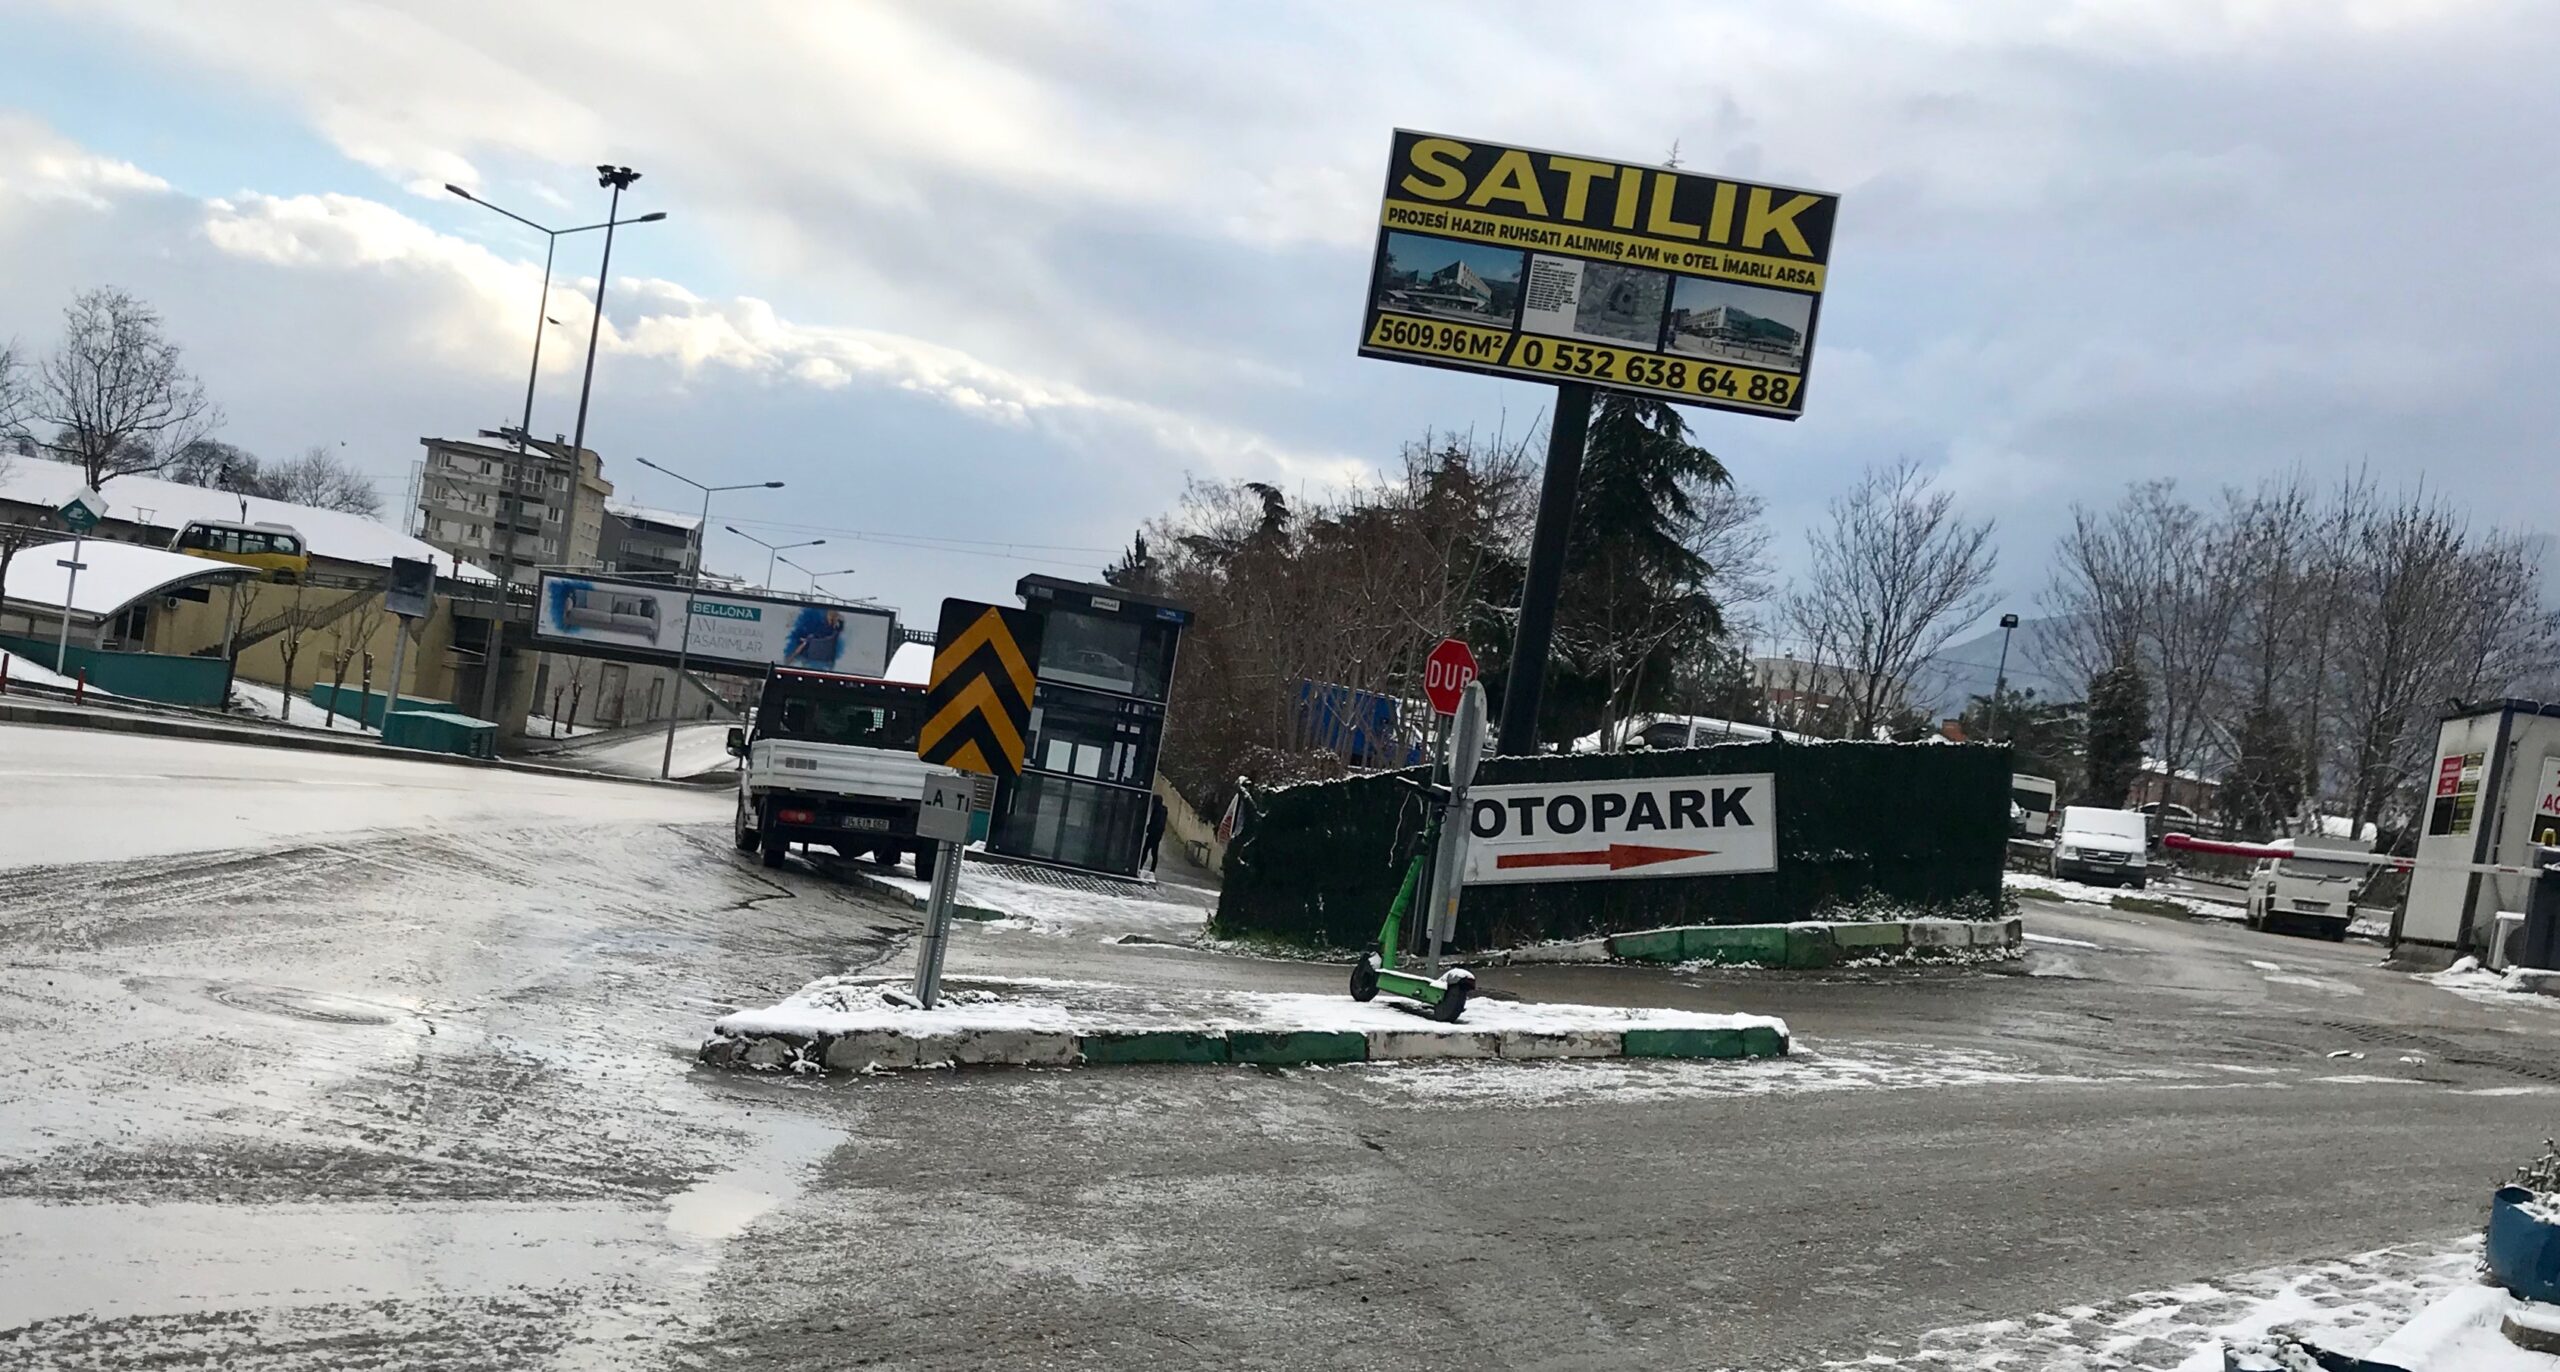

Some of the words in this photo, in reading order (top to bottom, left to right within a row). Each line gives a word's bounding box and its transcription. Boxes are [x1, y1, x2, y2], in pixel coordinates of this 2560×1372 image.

[1401, 138, 1823, 257] SATILIK
[1388, 207, 1449, 230] PROJESİ
[1451, 218, 1496, 237] HAZIR
[1500, 226, 1561, 247] RUHSATI
[1564, 234, 1623, 259] ALINMIŞ
[1627, 243, 1659, 261] AVM
[1663, 254, 1680, 265] ve
[1683, 253, 1719, 271] OTEL
[1776, 269, 1816, 286] ARSA
[1523, 340, 1543, 367] 0
[1553, 344, 1615, 378] 532
[1625, 356, 1686, 389] 638
[1698, 367, 1738, 397] 64
[1748, 375, 1789, 404] 88
[693, 602, 754, 619] BELLONA
[1428, 659, 1473, 693] DUR
[1469, 786, 1755, 838] OTOPARK
